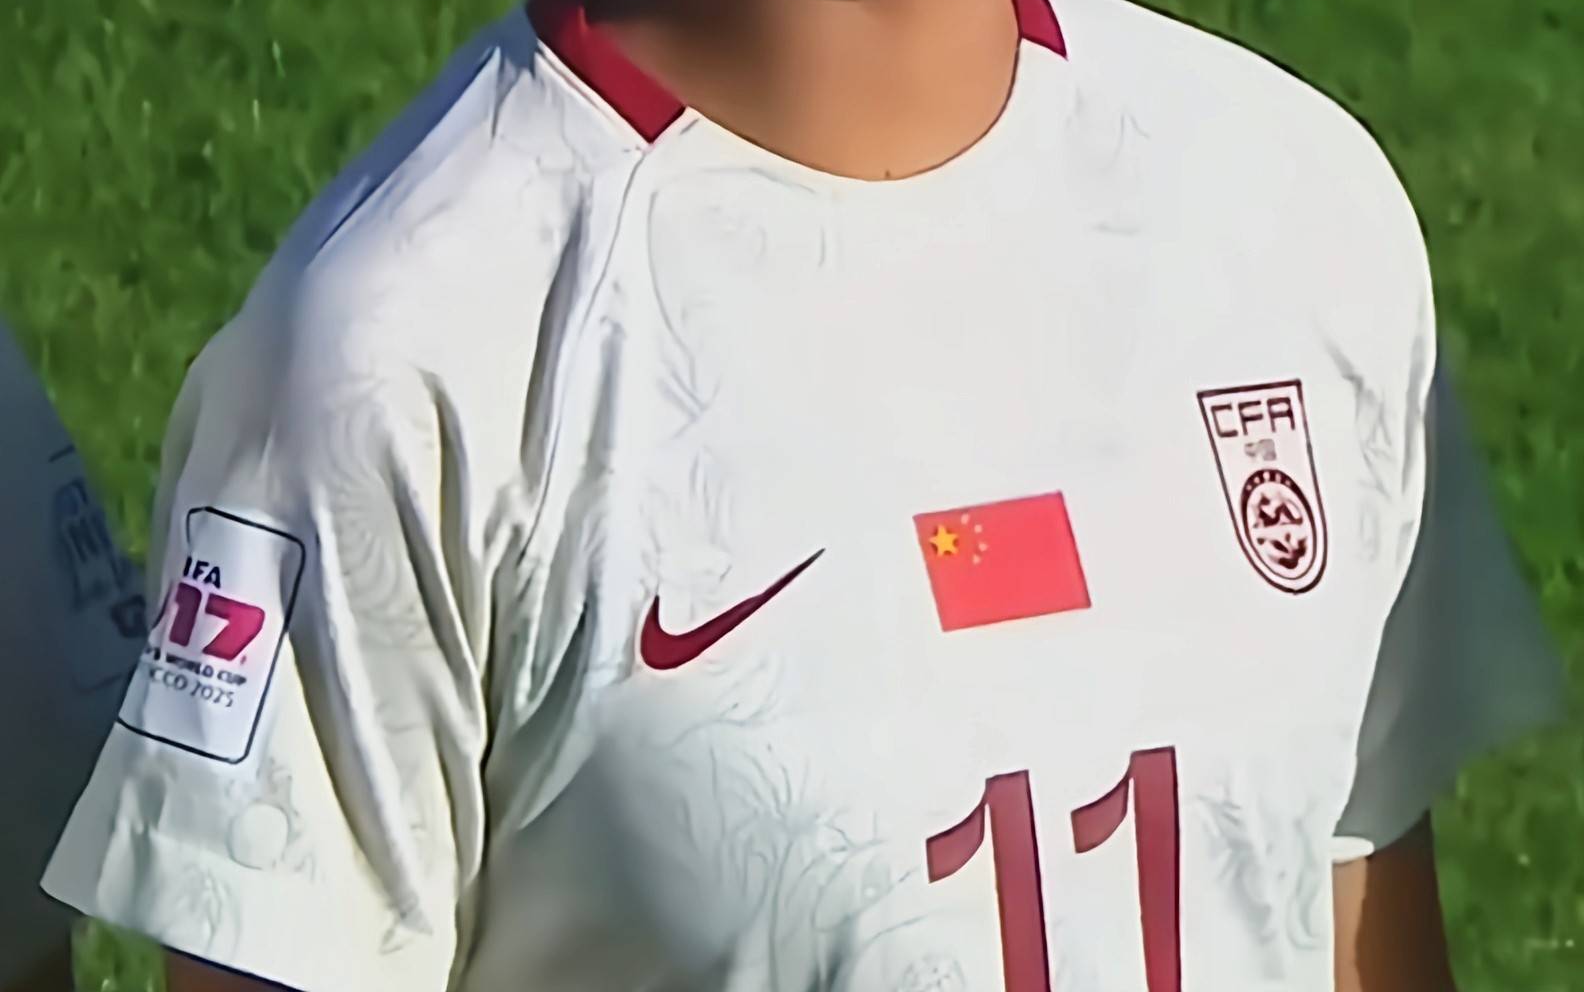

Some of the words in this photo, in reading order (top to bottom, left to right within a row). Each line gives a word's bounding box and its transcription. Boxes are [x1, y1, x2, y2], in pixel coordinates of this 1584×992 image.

[1211, 397, 1296, 438] CFA
[168, 582, 265, 662] 17
[926, 746, 1182, 992] 11
